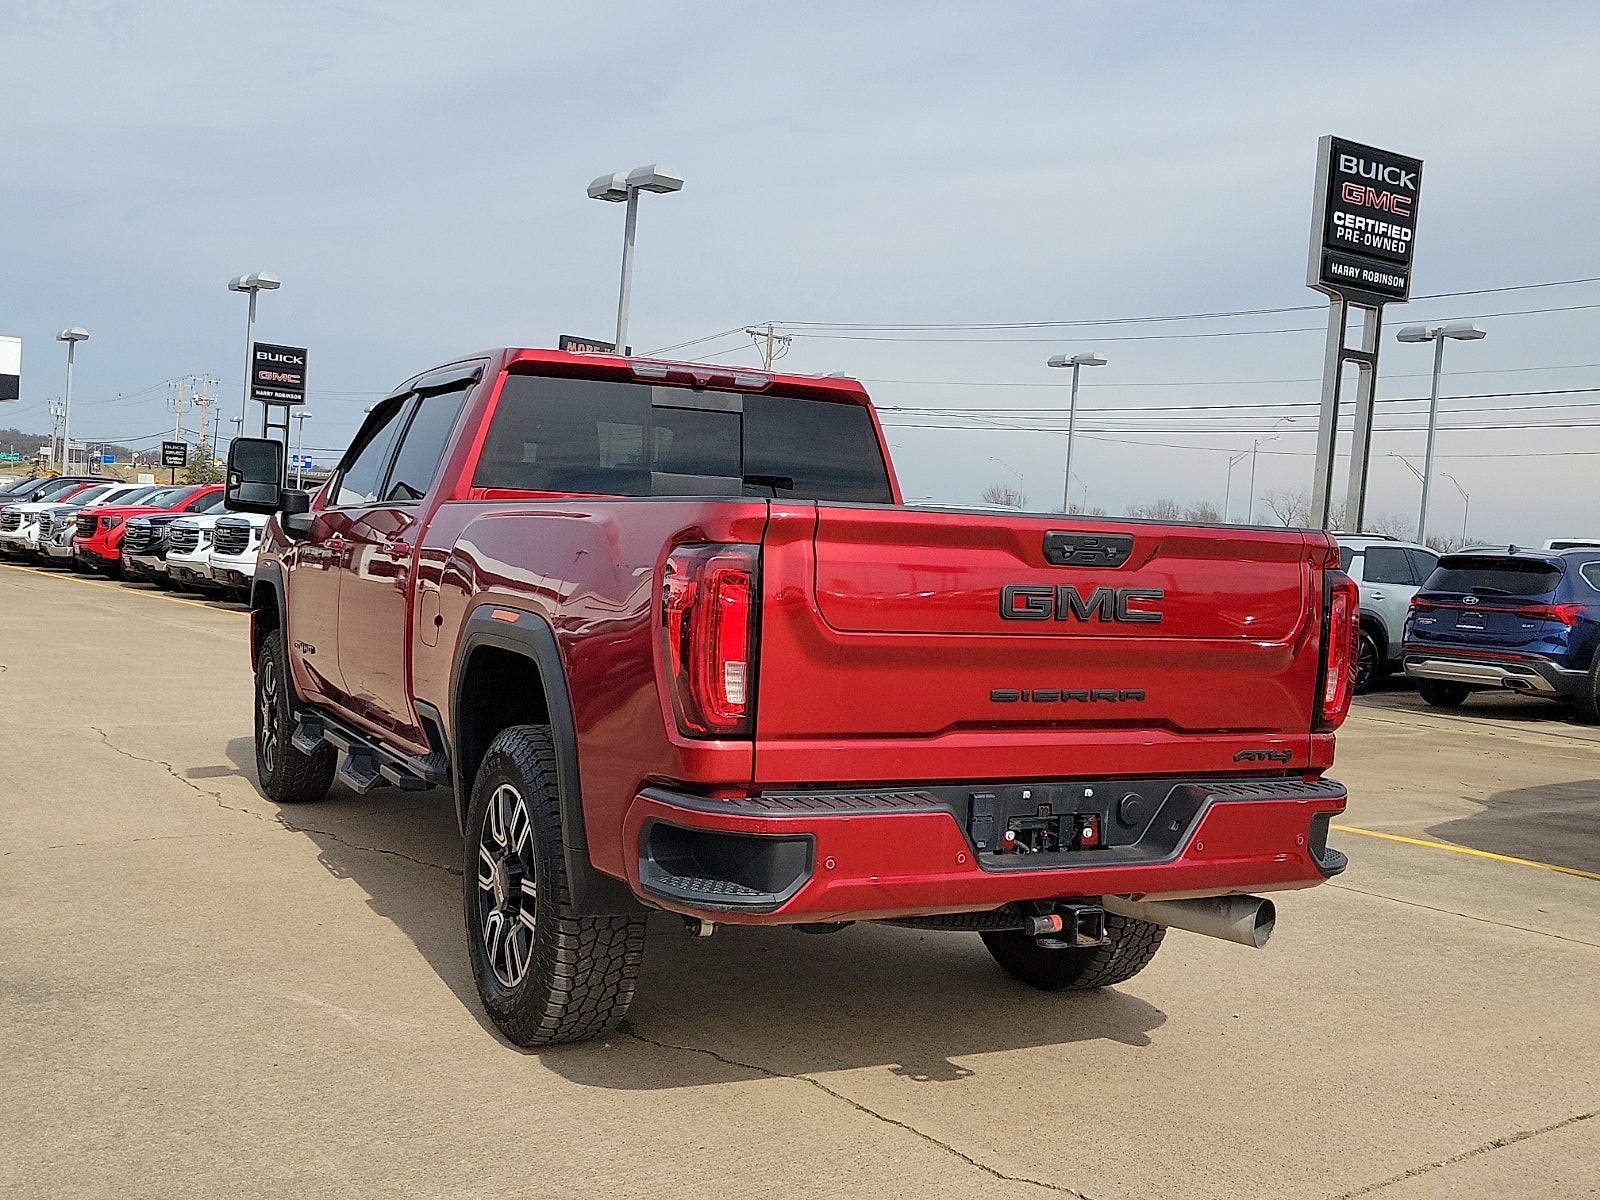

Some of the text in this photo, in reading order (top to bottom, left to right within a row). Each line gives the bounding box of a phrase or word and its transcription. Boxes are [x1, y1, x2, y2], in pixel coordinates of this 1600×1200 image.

[1339, 154, 1417, 191] BUICK
[1342, 181, 1412, 217] GMC
[1333, 211, 1412, 241] CERTIFIED
[1336, 226, 1406, 254] PRE-OWNED
[1331, 262, 1405, 288] HARRY ROBINSON
[256, 351, 304, 365] BUICK
[258, 370, 301, 384] GMC
[255, 389, 302, 400] HARRY ROBINSON
[1000, 583, 1165, 623] GMC
[990, 688, 1146, 702] SIERRA
[1233, 749, 1292, 764] AT4
